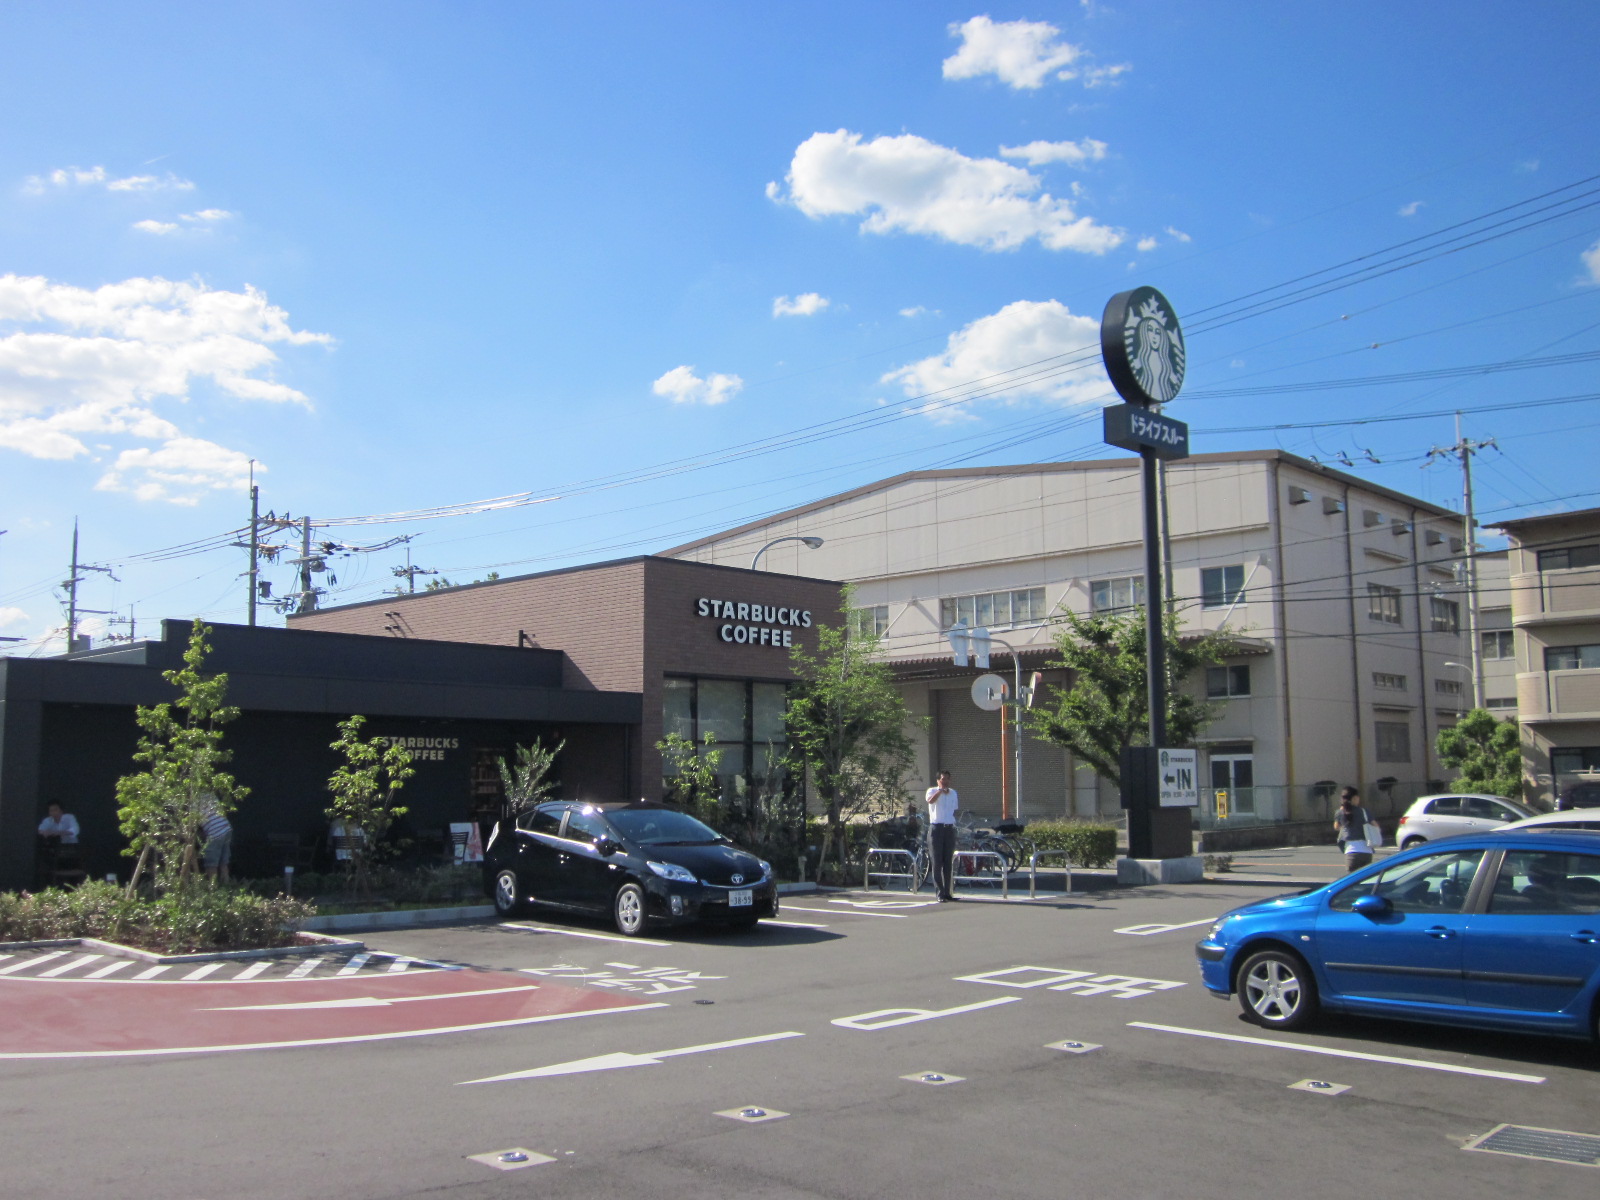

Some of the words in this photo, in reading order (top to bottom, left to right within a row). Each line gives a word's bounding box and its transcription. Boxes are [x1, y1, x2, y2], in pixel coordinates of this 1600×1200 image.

[1131, 413, 1185, 445] ドライブスルー
[697, 597, 812, 628] STARBUCKS
[720, 623, 792, 648] COFFEE
[382, 736, 459, 749] STARBUCKS
[401, 749, 445, 761] OFFEE
[1177, 768, 1192, 790] IN
